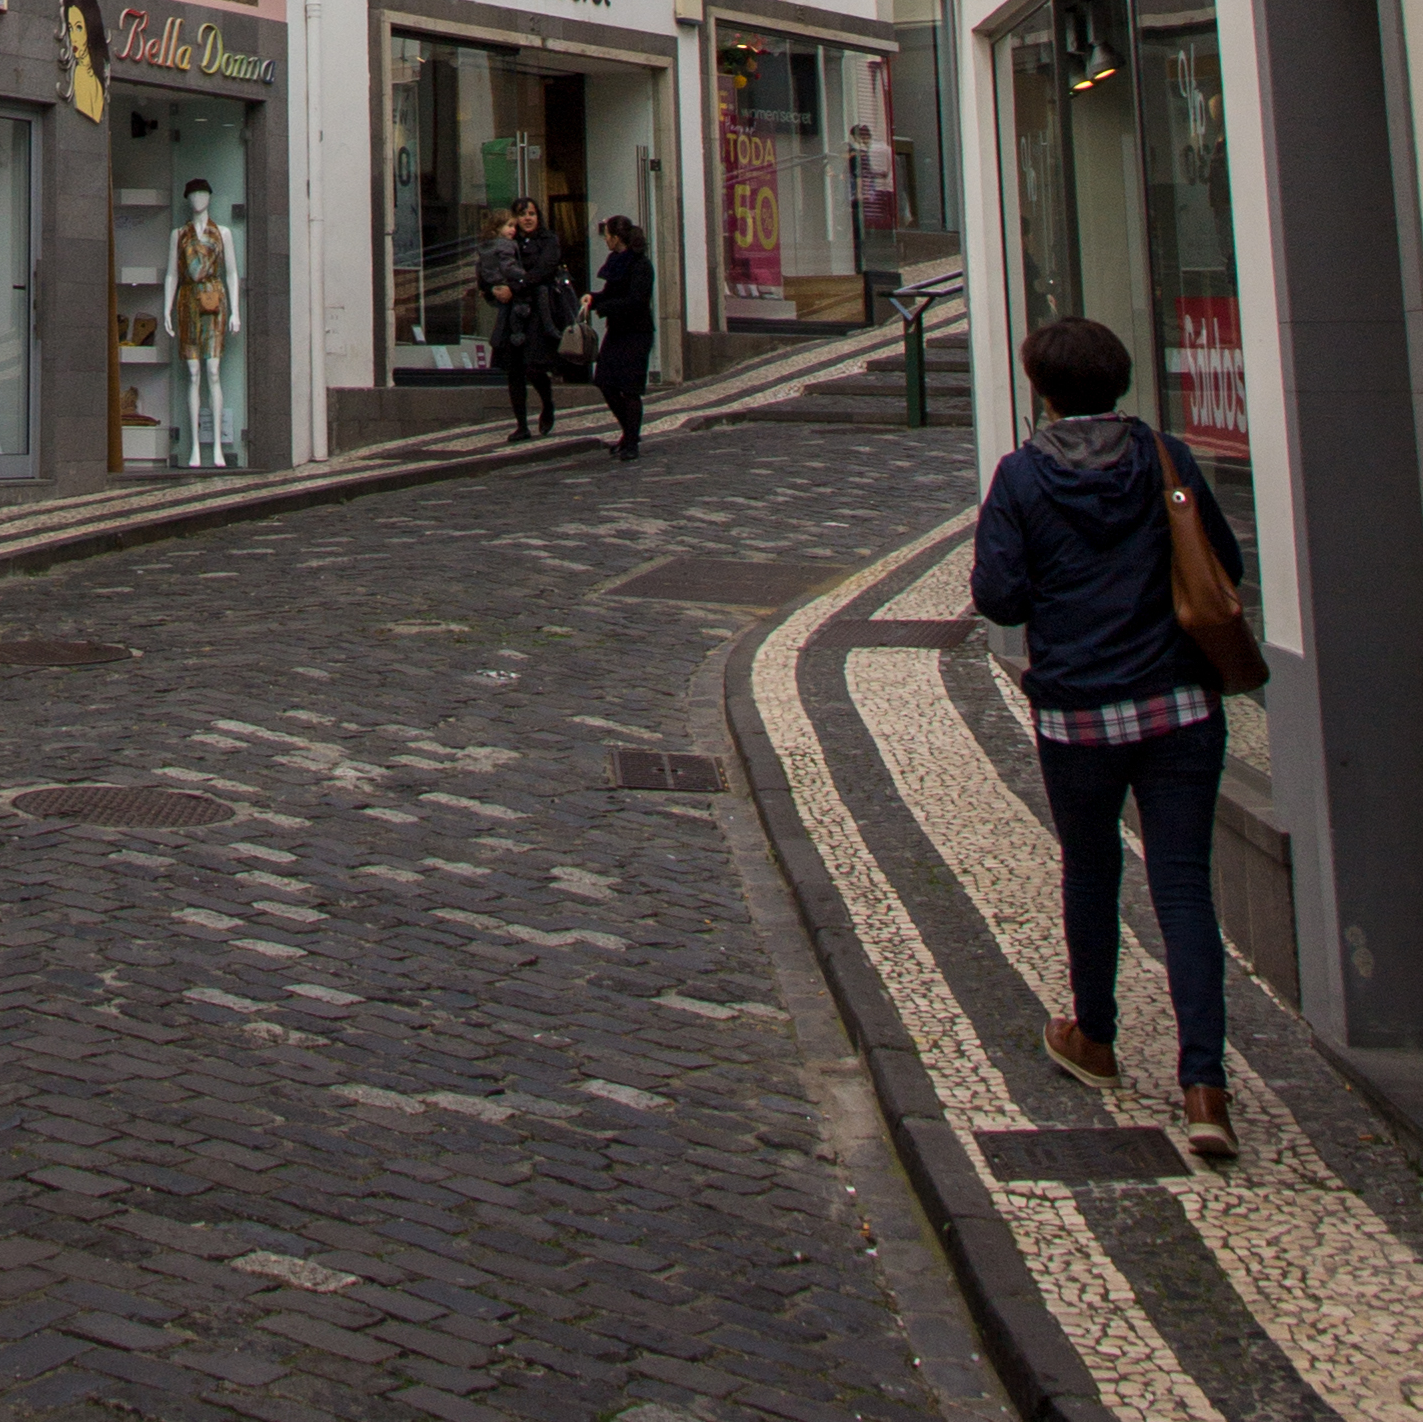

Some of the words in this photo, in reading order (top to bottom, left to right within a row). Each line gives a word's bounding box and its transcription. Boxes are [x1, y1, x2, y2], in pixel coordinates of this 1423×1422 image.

[115, 7, 193, 71] Bella
[197, 22, 277, 85] Donna
[726, 133, 776, 167] TODA
[1183, 313, 1247, 434] Saldos
